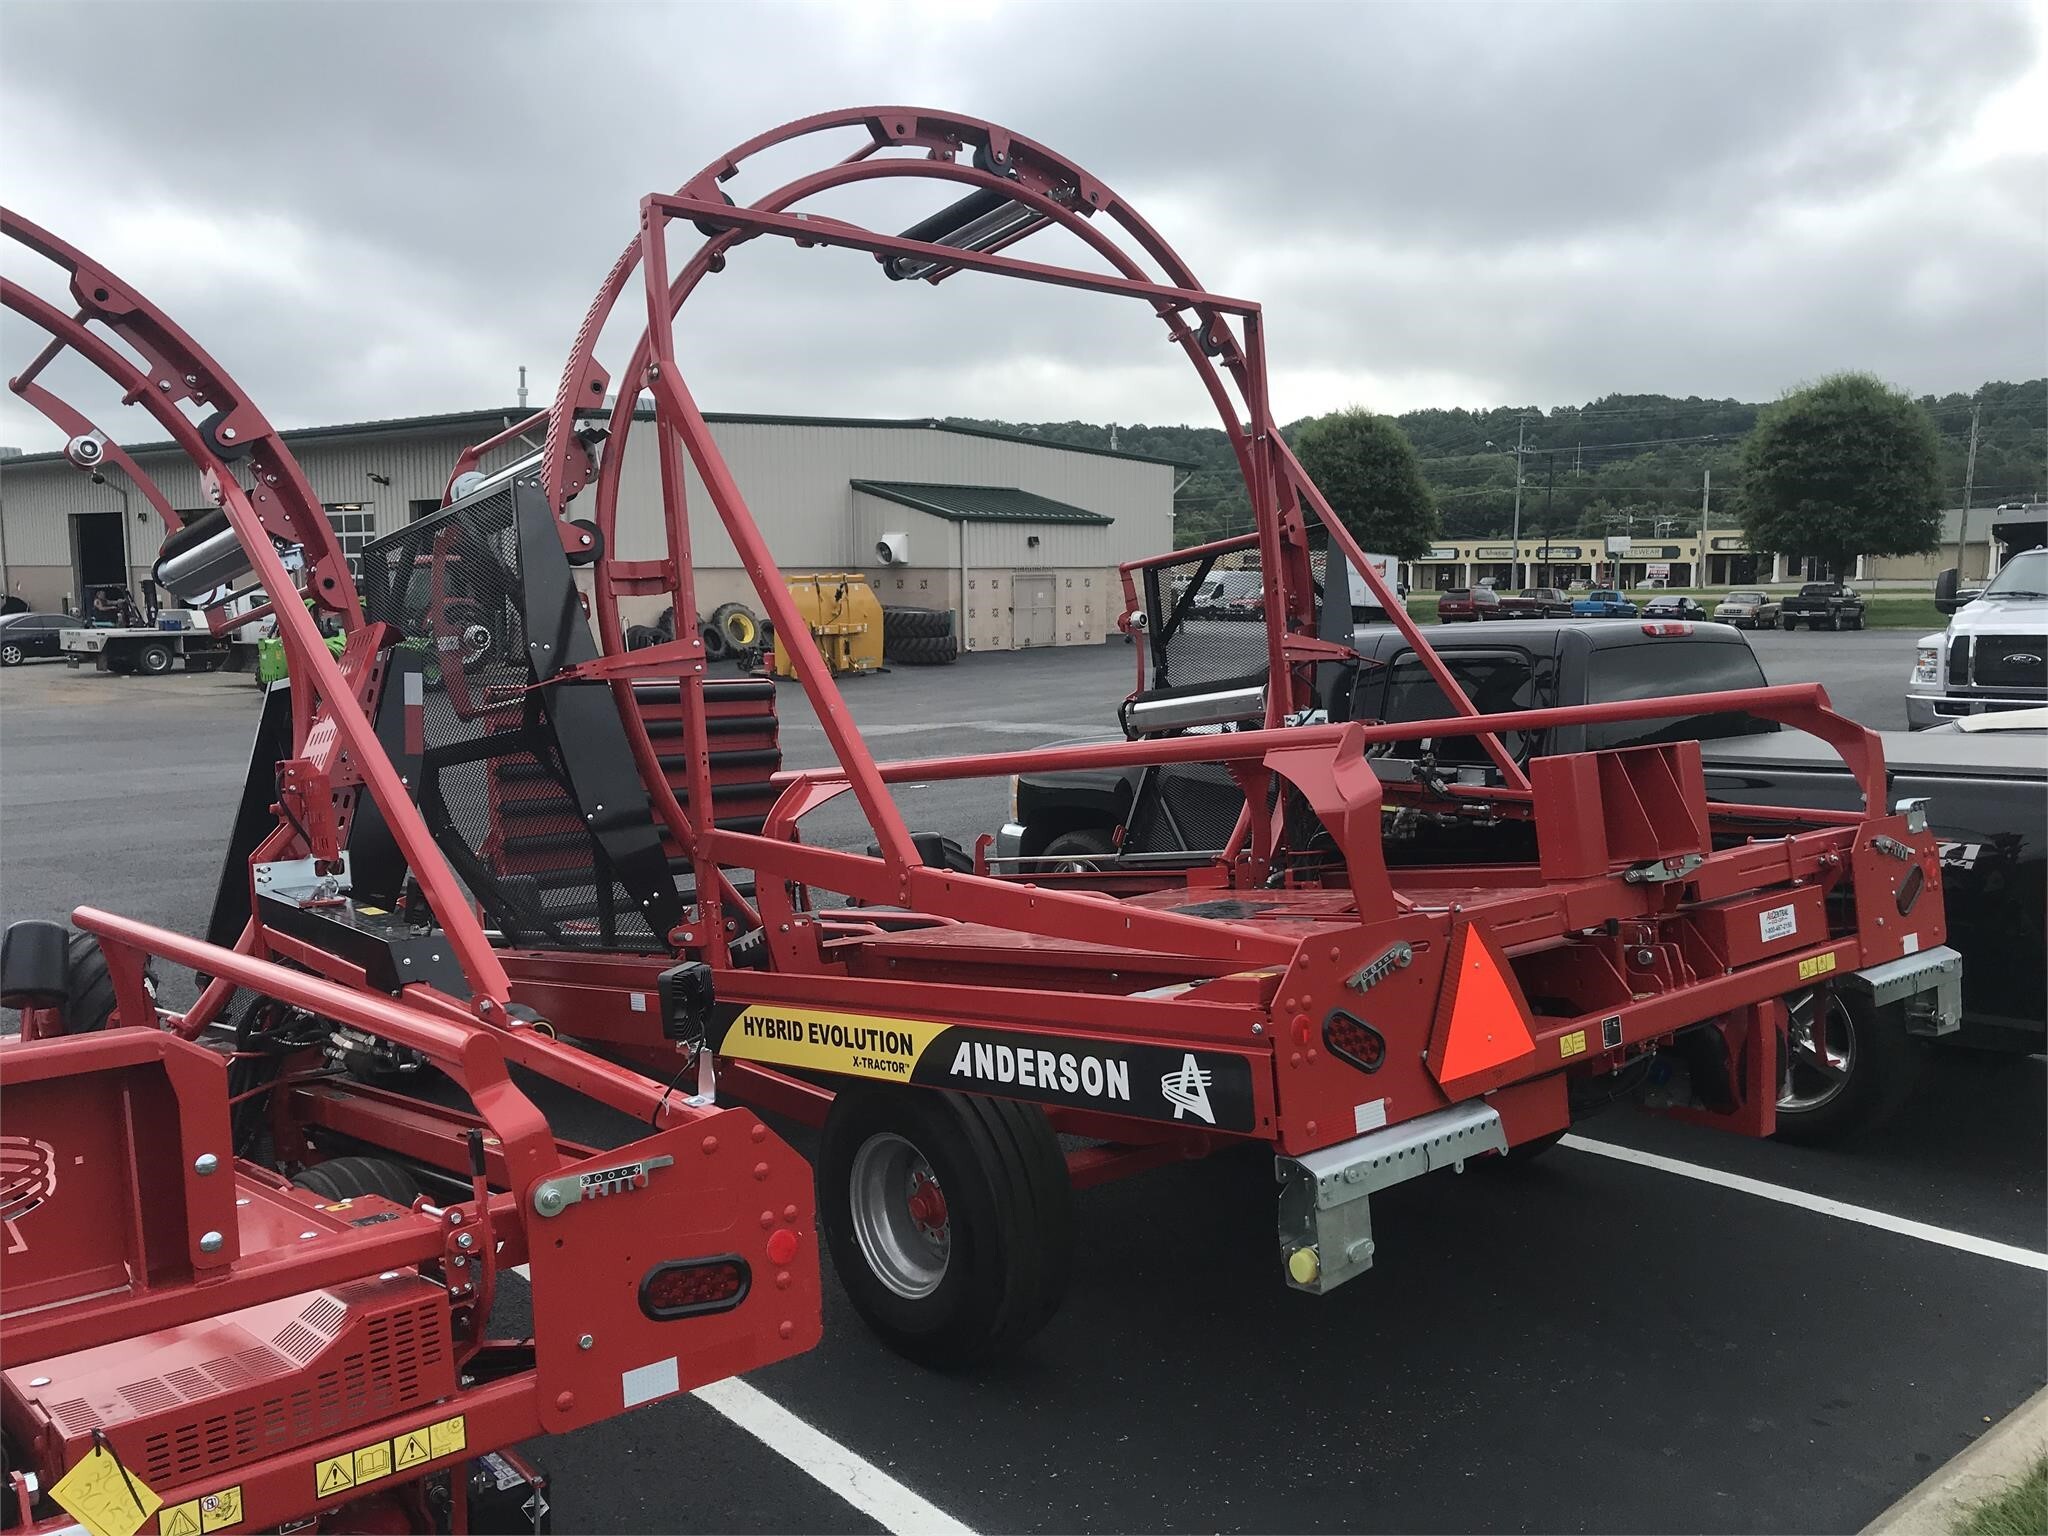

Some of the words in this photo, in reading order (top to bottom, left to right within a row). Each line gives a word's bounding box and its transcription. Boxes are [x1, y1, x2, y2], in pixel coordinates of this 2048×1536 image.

[744, 1016, 803, 1042] HYBRID
[808, 1023, 913, 1056] EVOLUTION
[950, 1041, 1130, 1101] ANDERSON
